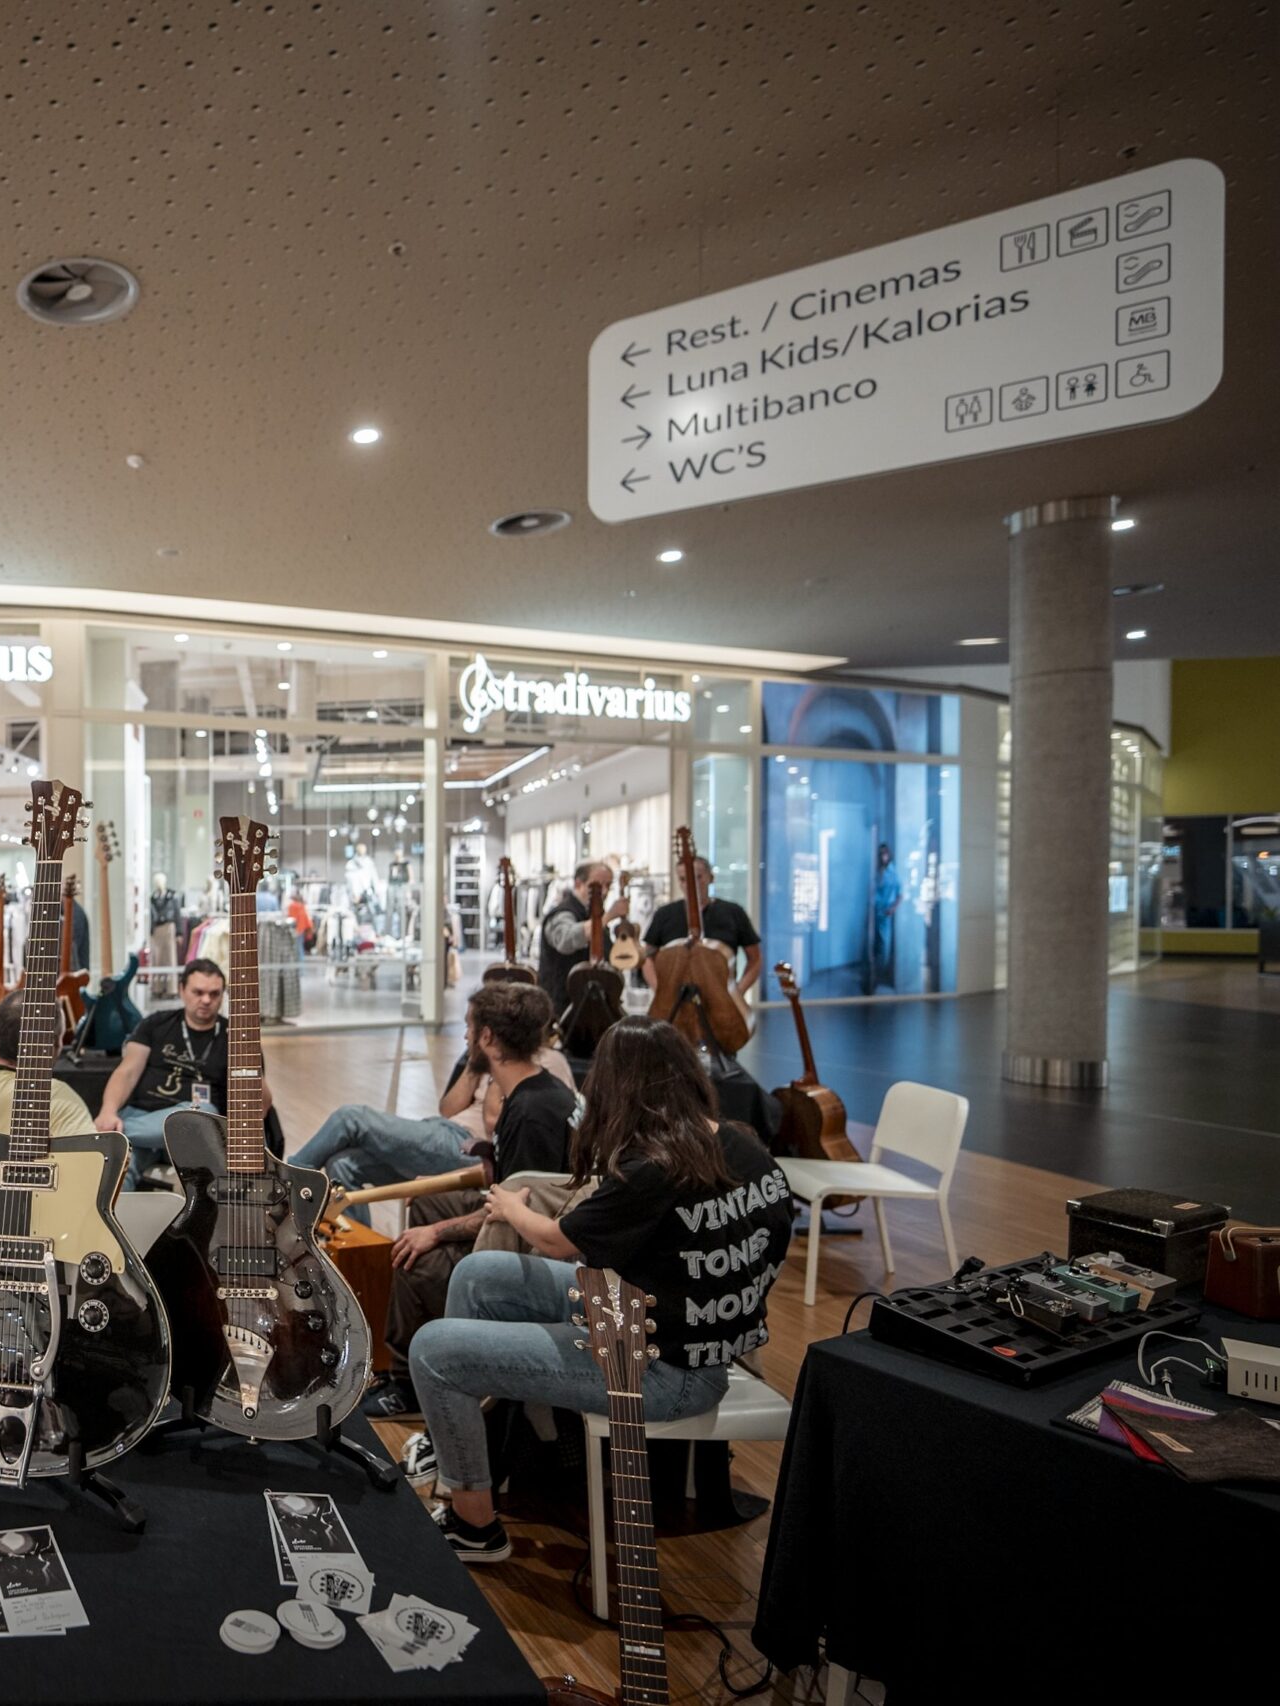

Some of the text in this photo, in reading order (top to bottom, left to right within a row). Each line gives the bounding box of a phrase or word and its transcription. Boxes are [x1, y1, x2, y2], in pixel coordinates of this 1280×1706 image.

[666, 259, 962, 357] Rest. / Cinemas
[667, 288, 1030, 397] Luna Kids/Kalorias
[667, 378, 878, 442] Multibanco
[668, 440, 767, 484] WC'S
[675, 1169, 789, 1233] VINTAGE
[679, 1227, 770, 1279] TONES
